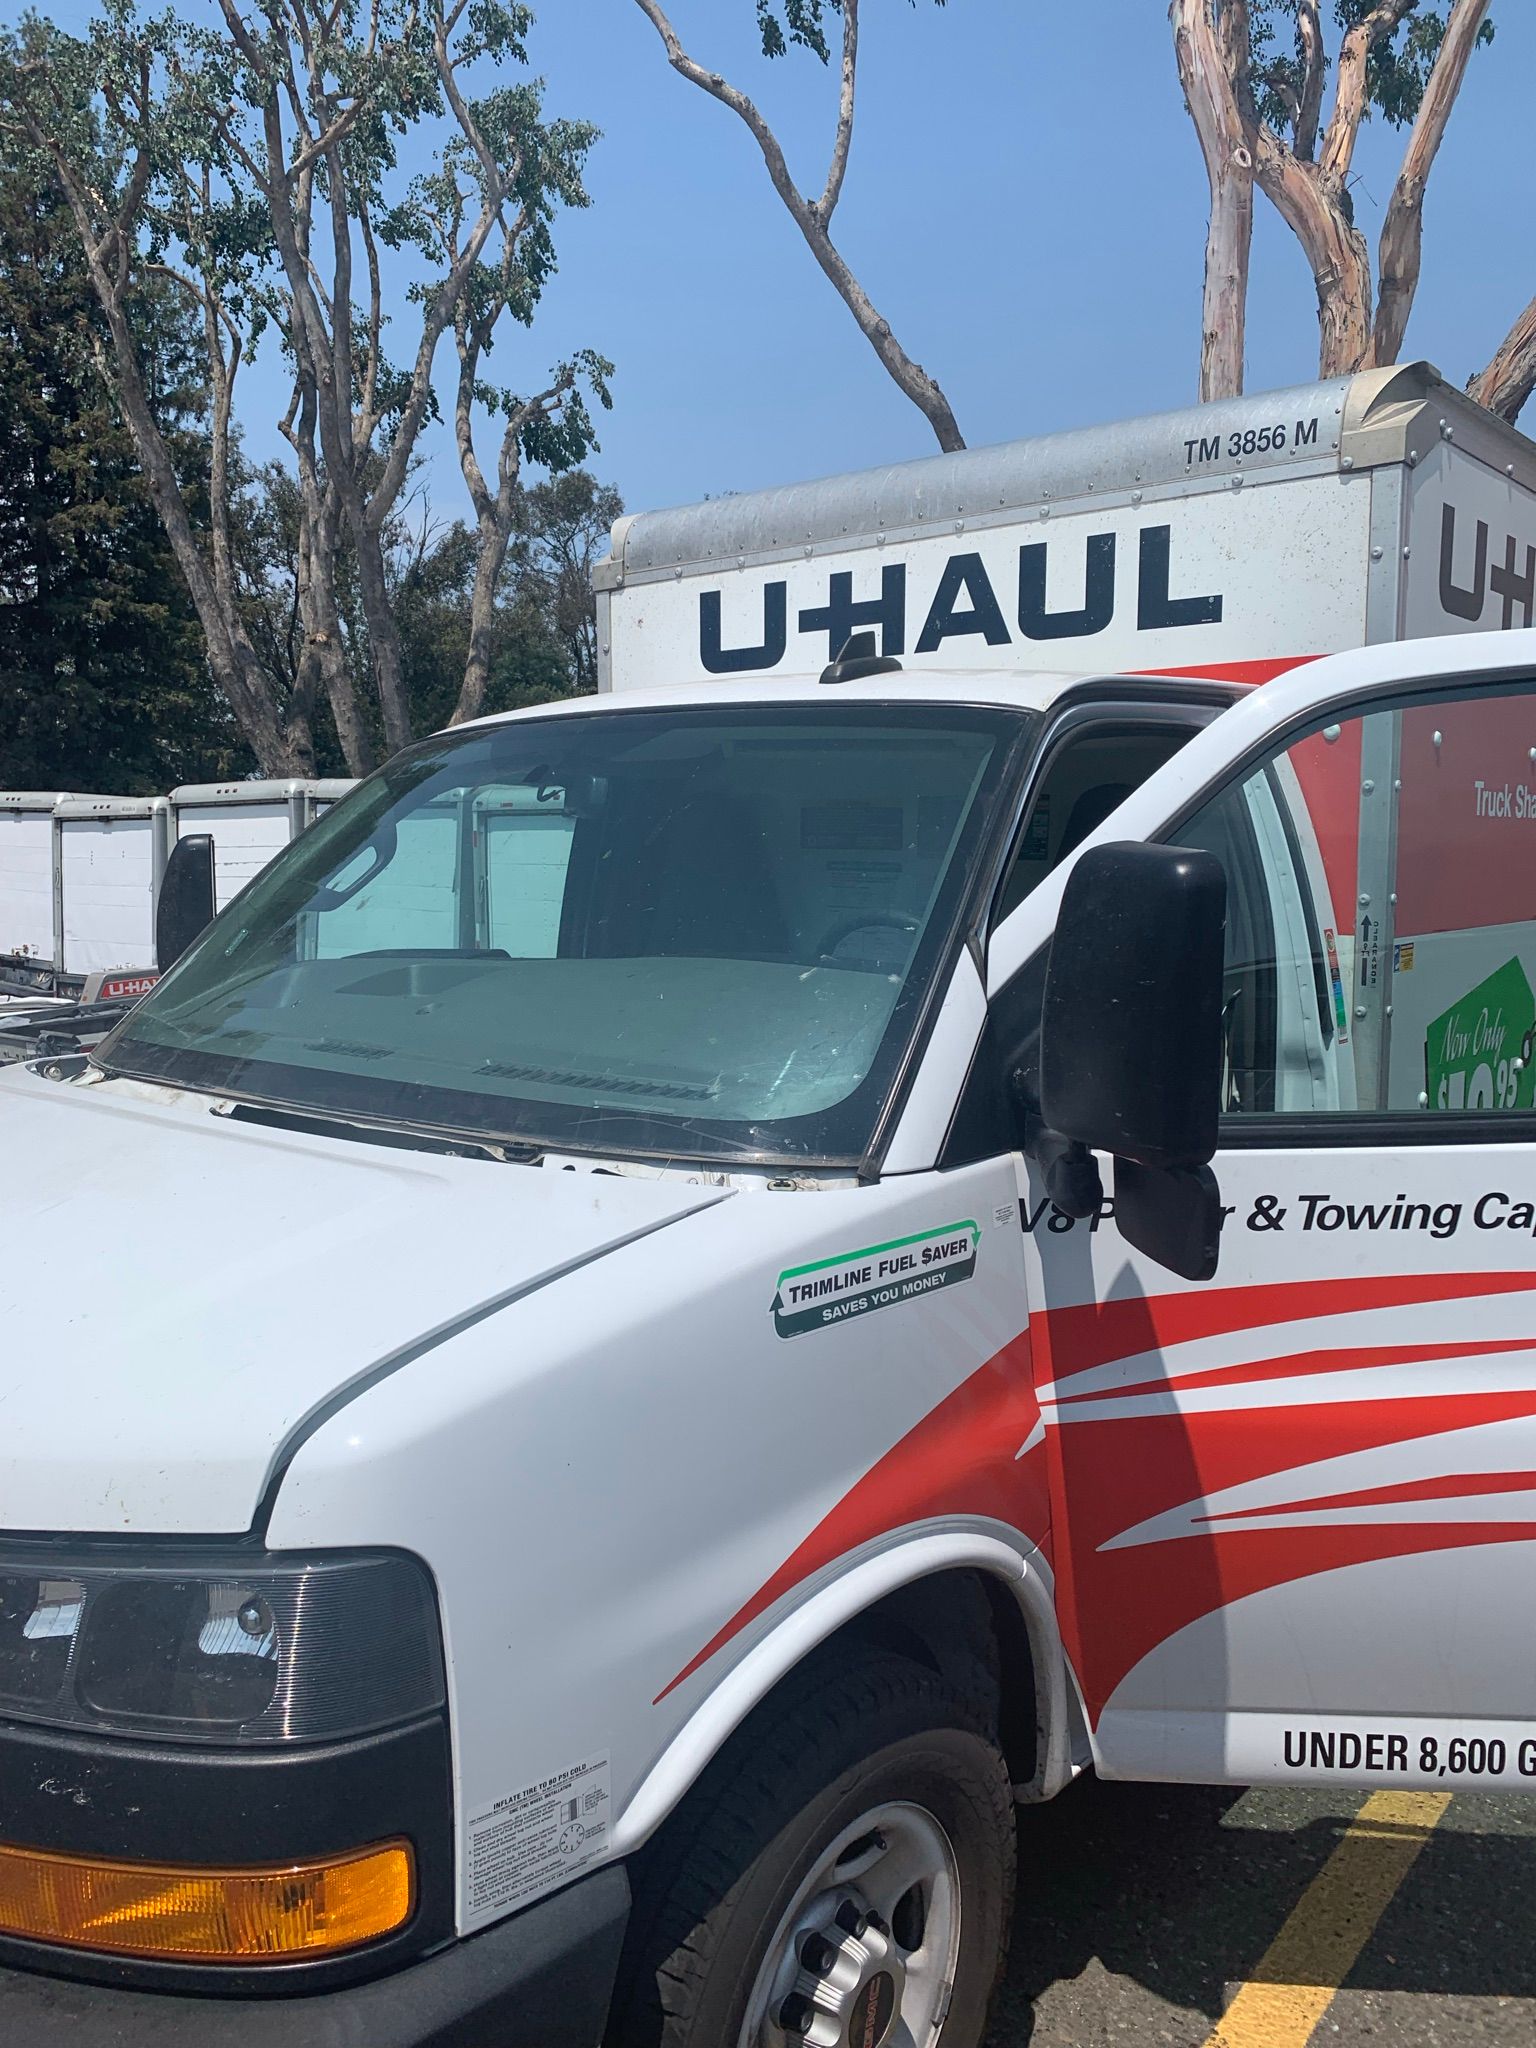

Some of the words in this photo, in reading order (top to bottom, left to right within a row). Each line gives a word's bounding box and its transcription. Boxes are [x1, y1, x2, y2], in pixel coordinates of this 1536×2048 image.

[1184, 436, 1220, 464] TM
[1228, 425, 1285, 457] 3856
[1295, 418, 1318, 446] M
[700, 524, 1222, 673] U-HAUL
[1475, 781, 1512, 817] Truck
[109, 979, 158, 996] U-HA
[1440, 1014, 1471, 1065] Now
[1473, 1007, 1508, 1068] Only
[1246, 1195, 1285, 1231] &
[1298, 1194, 1463, 1239] Towing
[1474, 1192, 1536, 1237] Ca
[789, 1267, 871, 1303] TRIMLINE
[879, 1255, 917, 1278] FUEL
[822, 1298, 868, 1321] SAVES
[871, 1288, 899, 1305] YOU
[903, 1272, 947, 1295] MONEY
[1284, 1731, 1408, 1771] UNDER
[1419, 1737, 1505, 1777] 8,600
[493, 1794, 521, 1810] INFLATE
[522, 1786, 537, 1798] TIRE
[539, 1782, 547, 1790] TO
[558, 1772, 569, 1782] PSI
[570, 1763, 587, 1776] COLD
